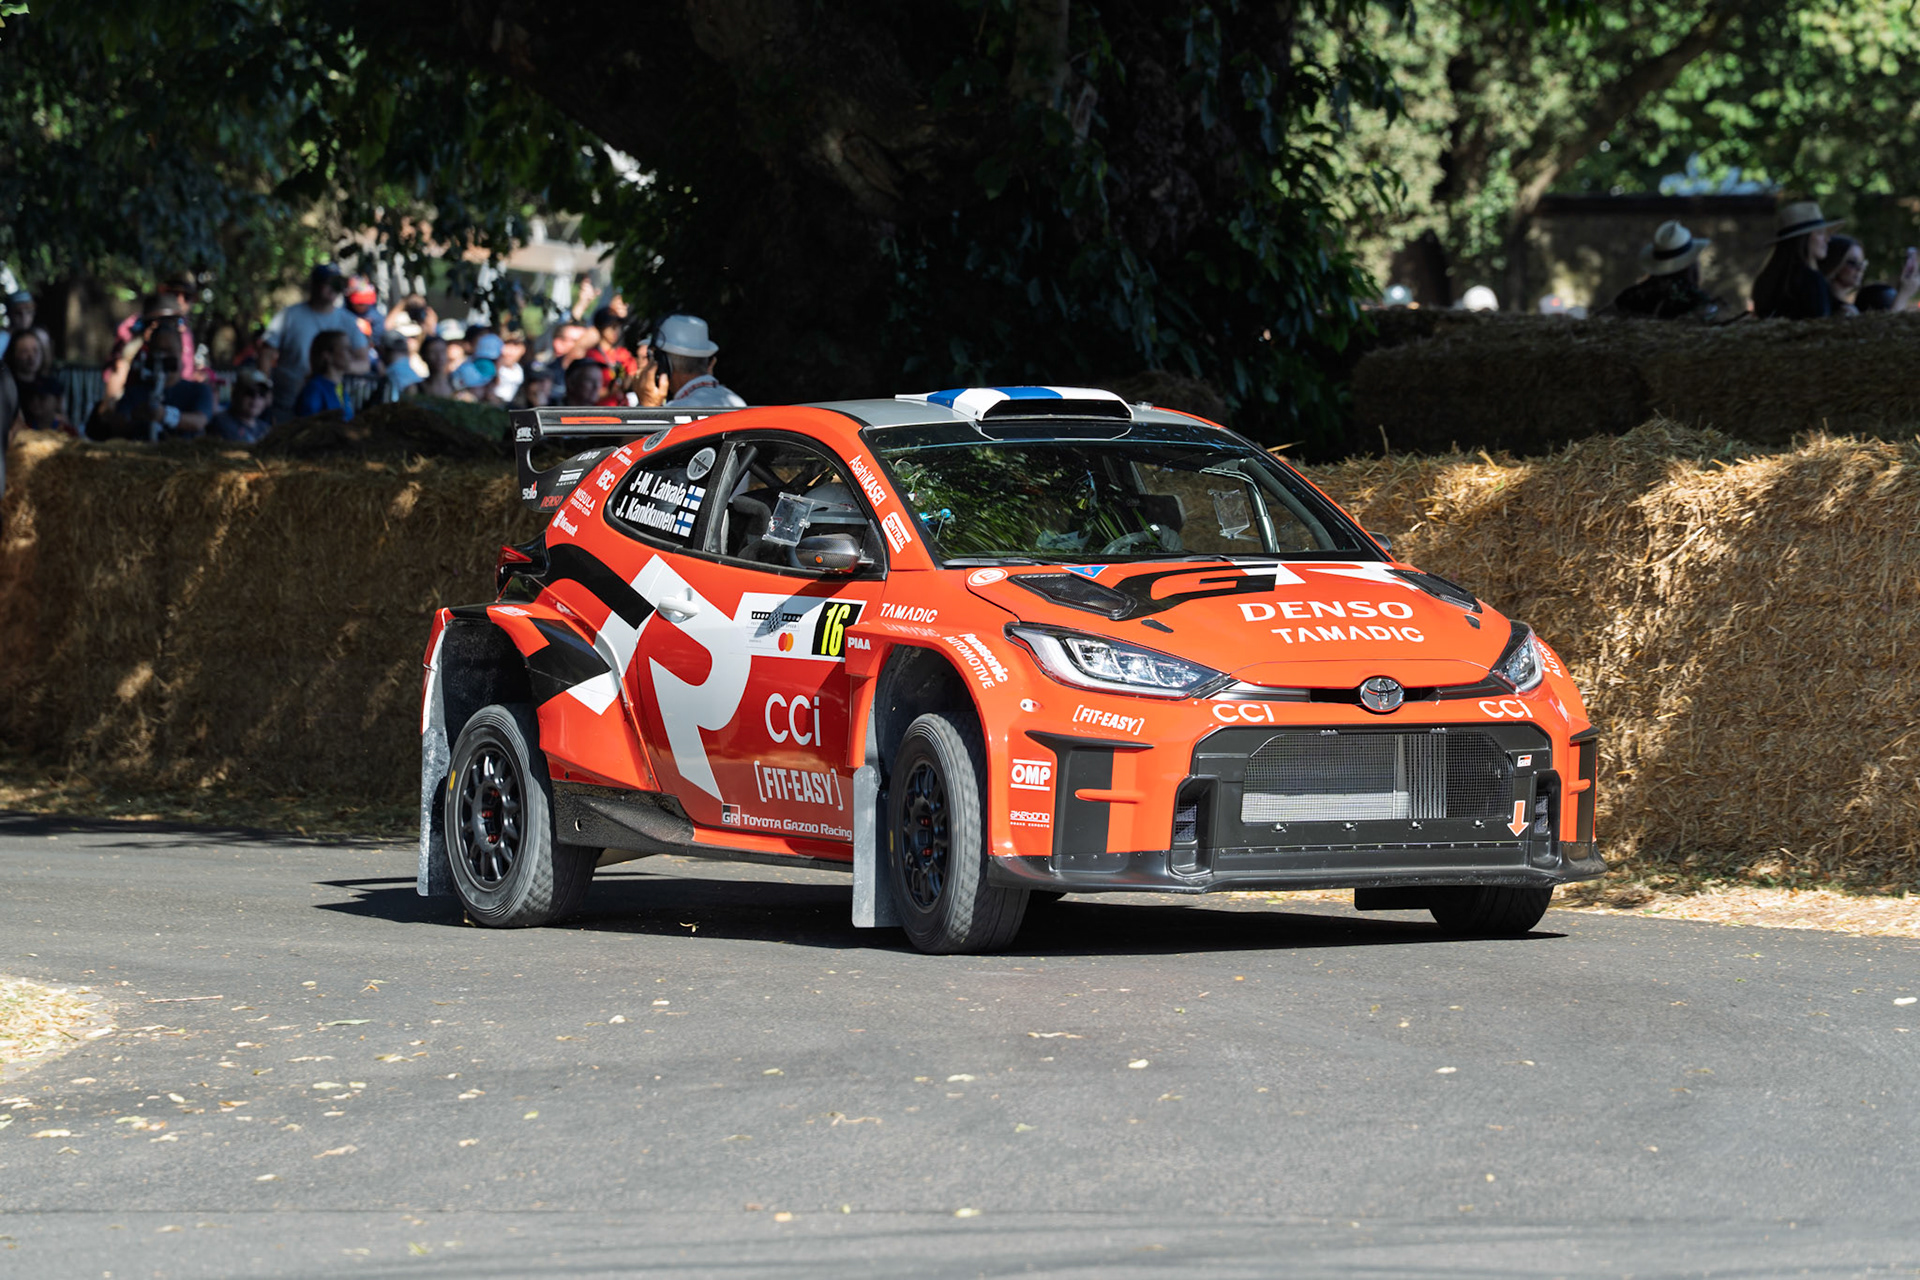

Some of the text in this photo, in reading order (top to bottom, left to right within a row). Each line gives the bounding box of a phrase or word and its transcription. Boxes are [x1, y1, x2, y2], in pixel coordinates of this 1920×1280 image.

[650, 476, 687, 506] Latvala
[849, 454, 887, 507] AsahiKASEI
[573, 487, 597, 511] NISULA
[615, 495, 677, 533] J. Kankkunen
[879, 602, 939, 624] TAMADIC
[1237, 601, 1414, 622] DENSO
[820, 603, 851, 656] 16
[1271, 626, 1425, 644] TAMADIC
[847, 637, 872, 651] PIAA
[958, 633, 1009, 683] Panasonic
[942, 636, 996, 690] AUTOMOTIVE
[765, 693, 821, 747] CCi
[1011, 764, 1051, 786] OMP
[742, 814, 782, 829] TOYOTA
[783, 819, 819, 834] GAZOO
[820, 823, 853, 841] Racing
